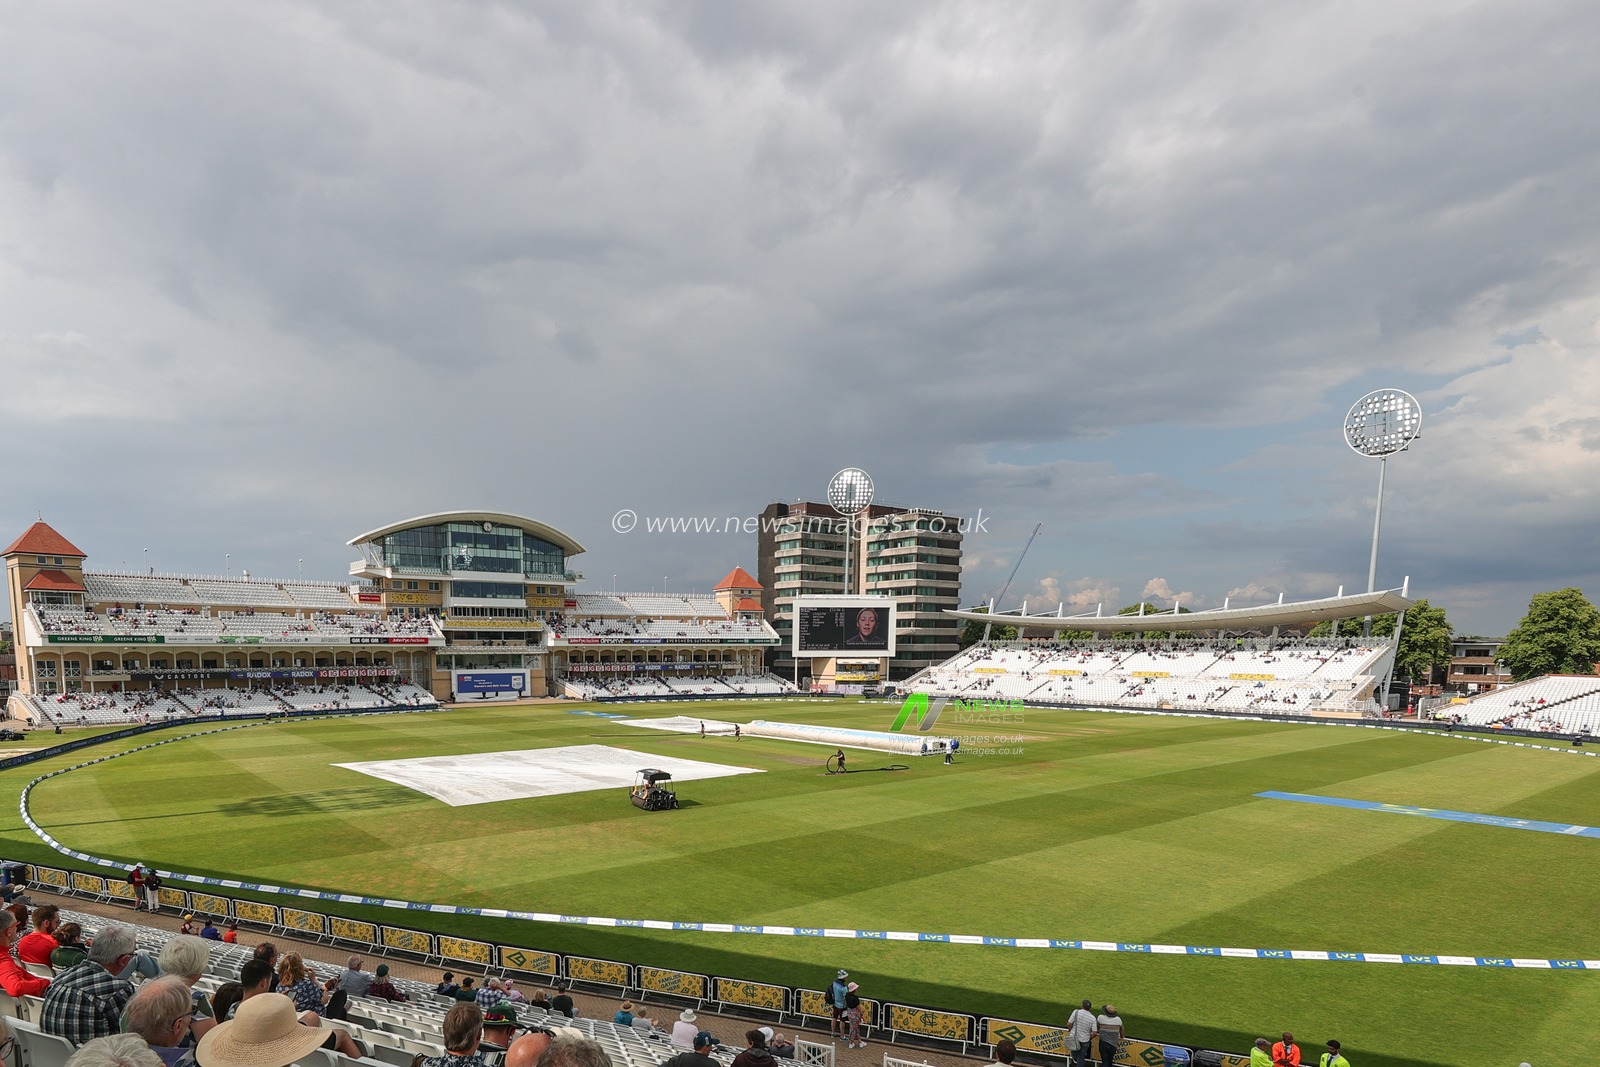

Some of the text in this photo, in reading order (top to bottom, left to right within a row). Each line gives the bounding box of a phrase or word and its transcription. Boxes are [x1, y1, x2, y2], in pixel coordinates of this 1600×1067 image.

[530, 955, 551, 964] FAMILIES
[658, 974, 681, 983] FAMILIES
[661, 979, 681, 988] GATHER
[915, 1027, 943, 1035] OUTLAWS
[1031, 1030, 1064, 1042] FAMILIES
[1034, 1036, 1064, 1048] GATHER
[1043, 1043, 1062, 1051] HERE
